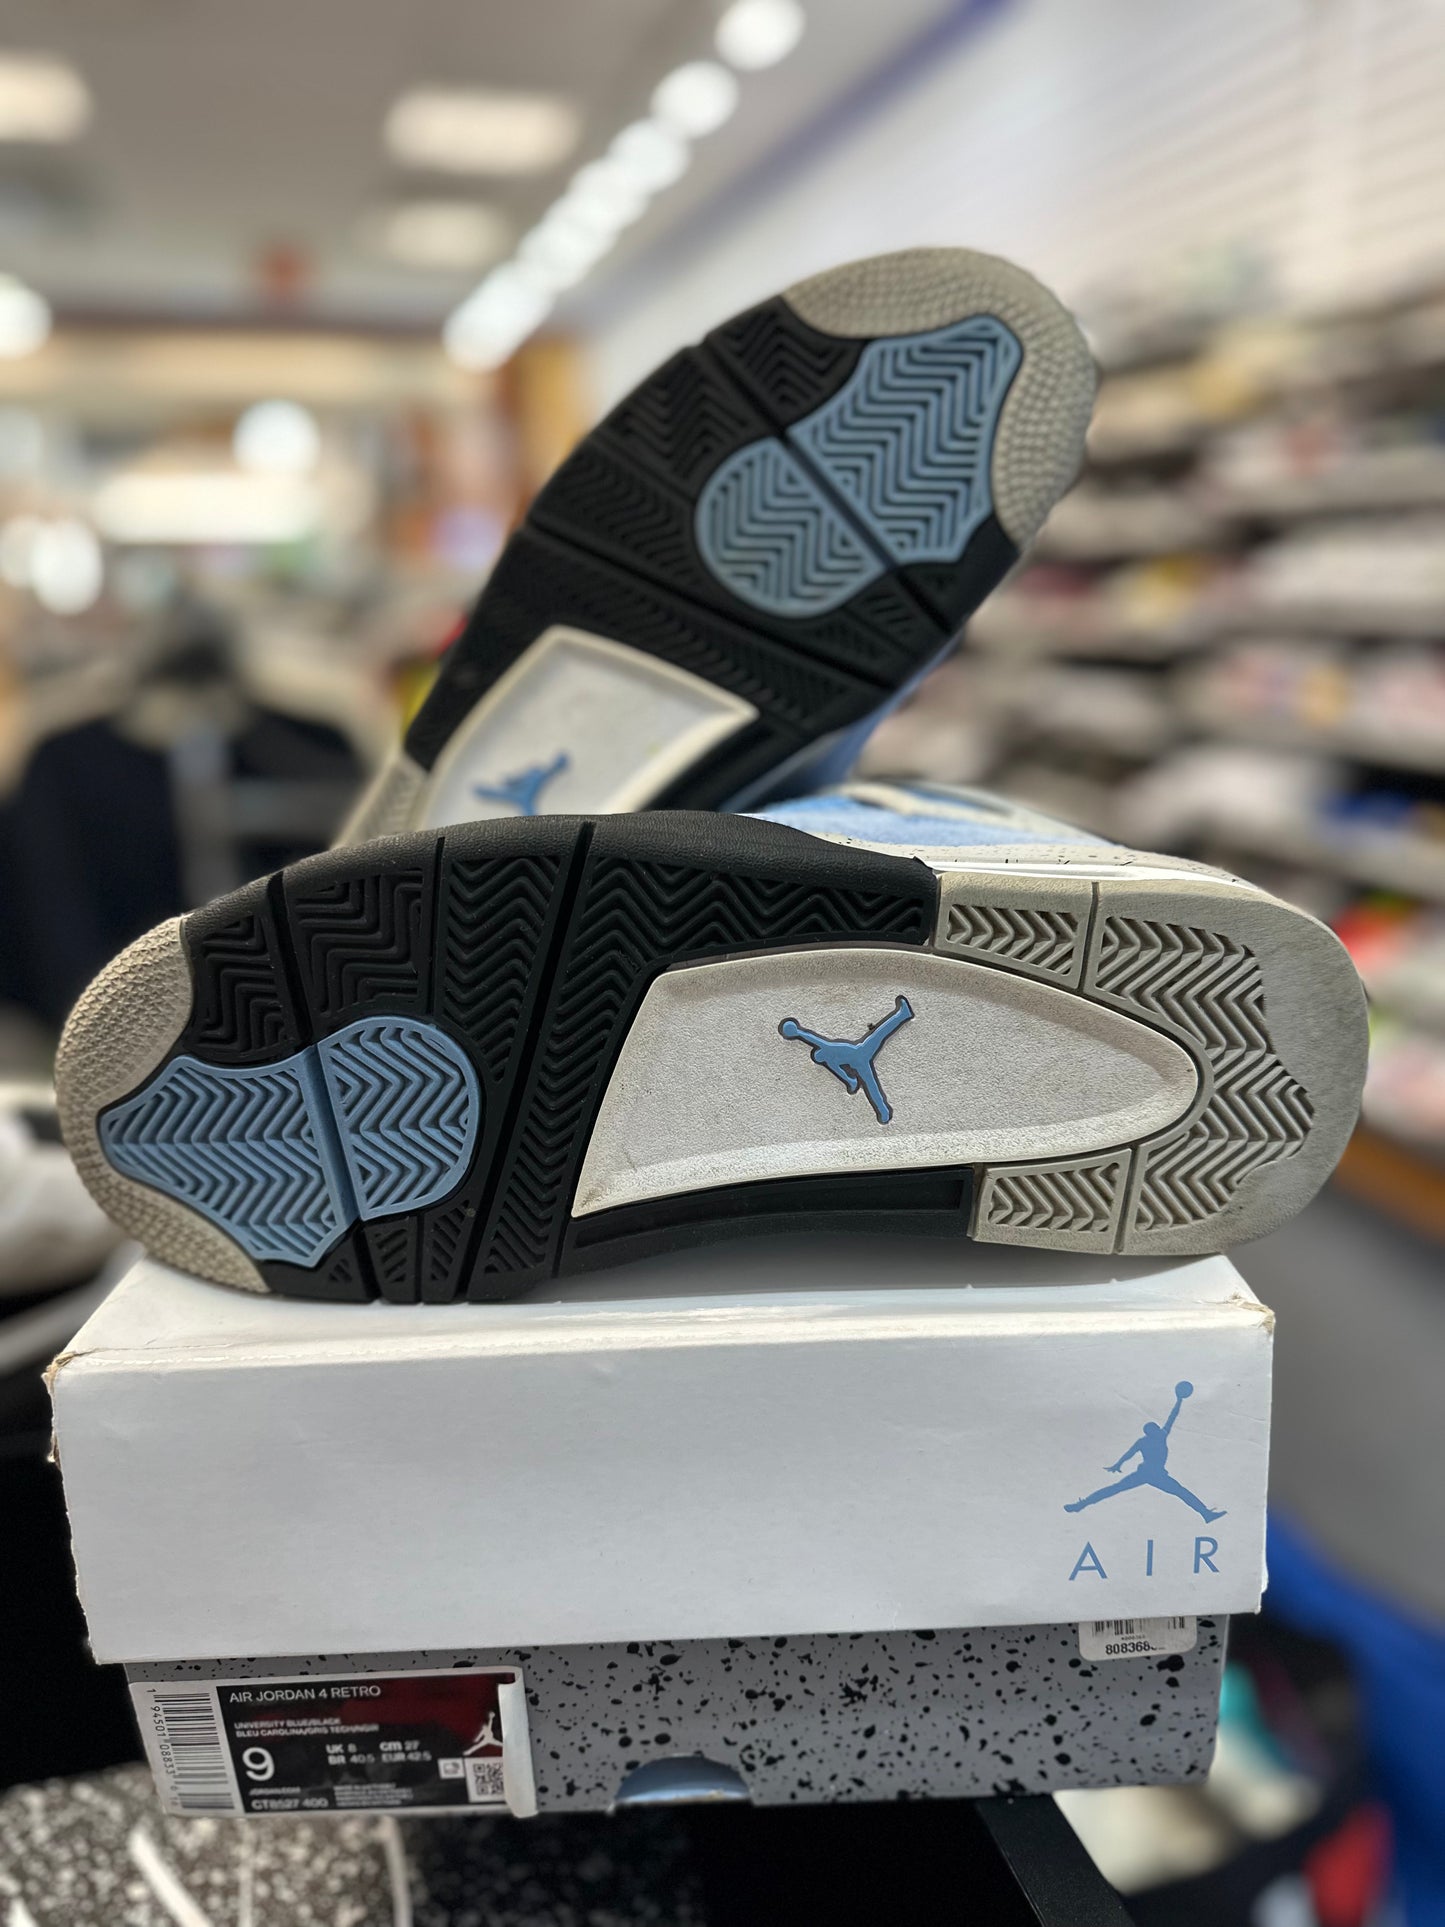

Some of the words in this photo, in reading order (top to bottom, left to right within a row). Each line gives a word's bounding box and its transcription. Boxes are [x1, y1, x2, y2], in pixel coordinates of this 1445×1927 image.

[1069, 1536, 1220, 1581] AIR
[1105, 1640, 1166, 1655] 808368
[229, 1691, 253, 1703] AIR
[256, 1688, 316, 1702] JORDAN
[318, 1688, 328, 1699] 4
[331, 1685, 381, 1698] RETRO
[325, 1744, 344, 1754] UK
[242, 1747, 275, 1781] 9
[327, 1755, 346, 1766] BR
